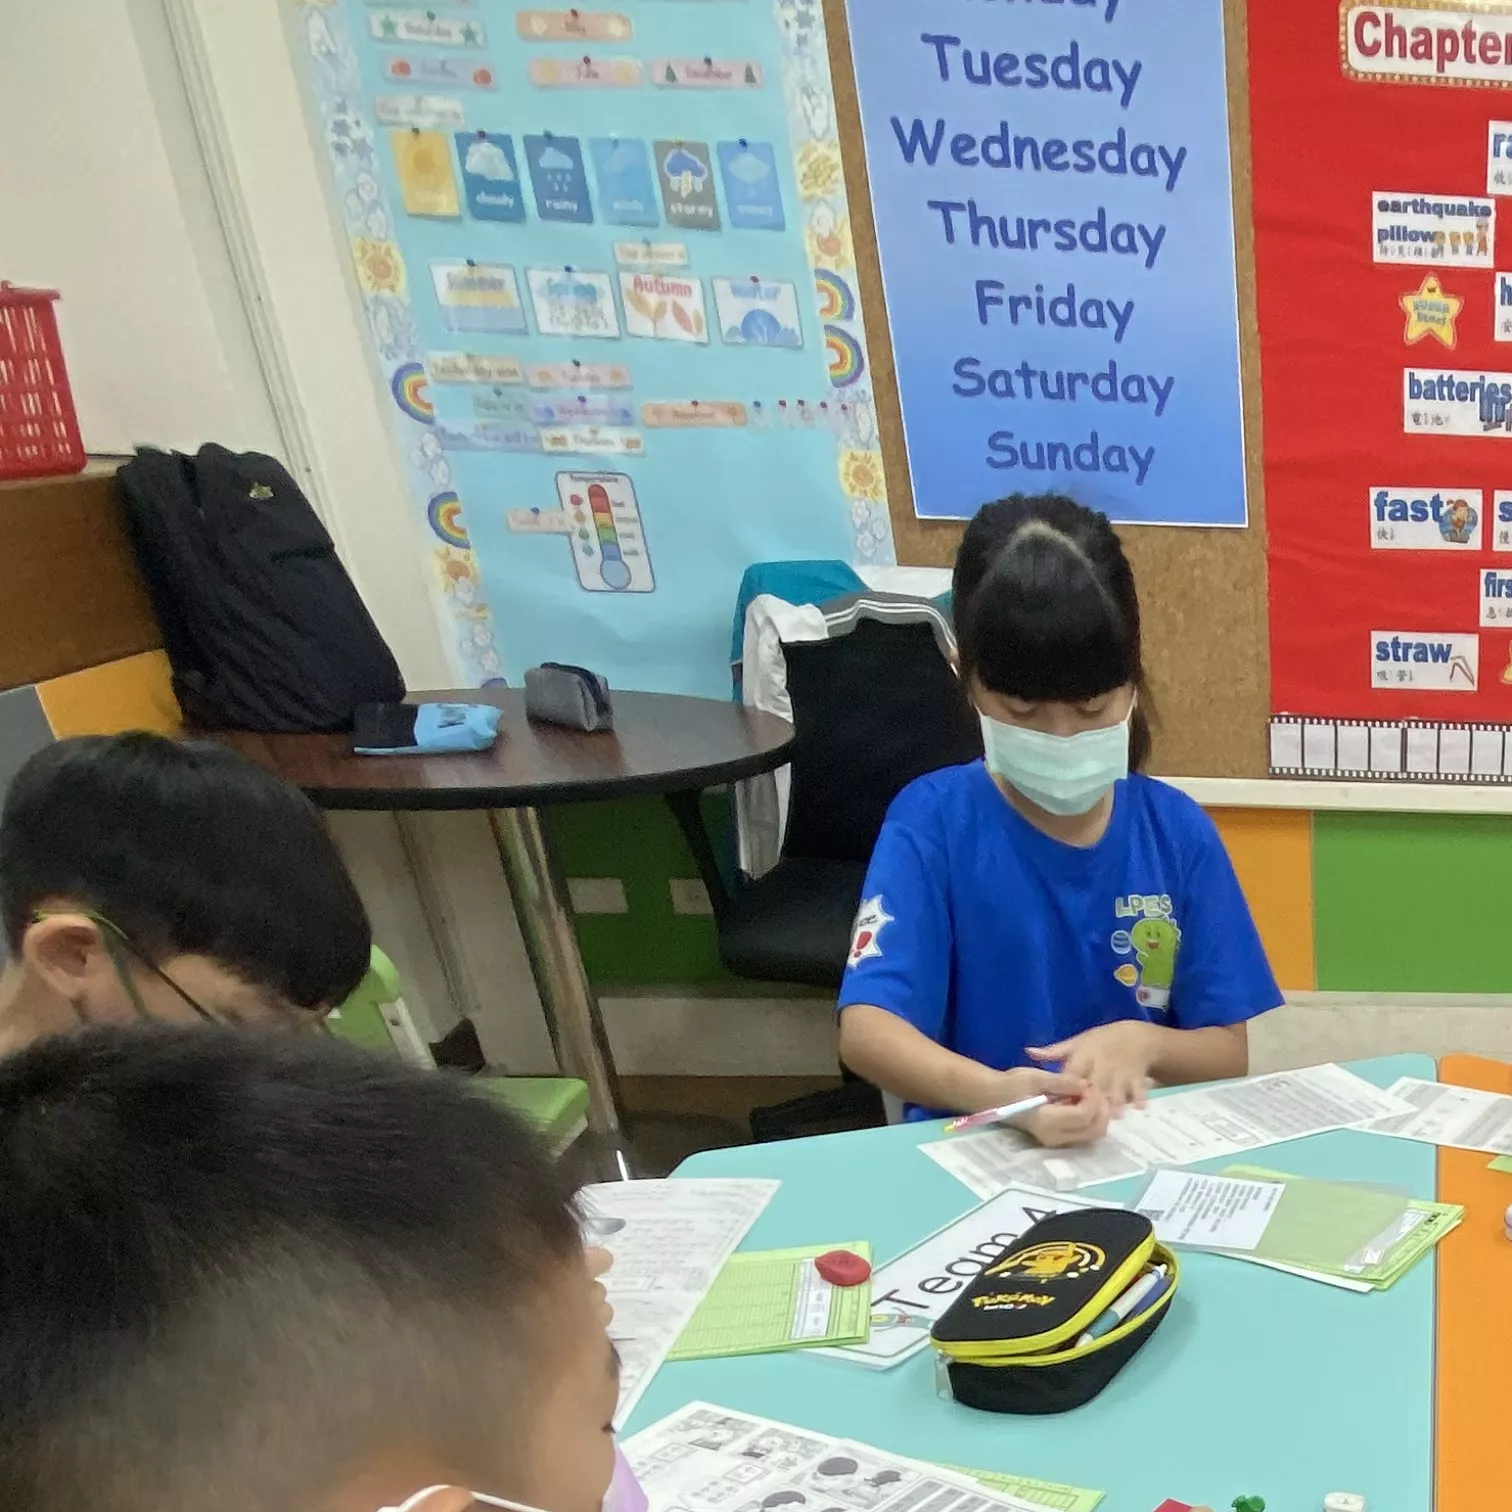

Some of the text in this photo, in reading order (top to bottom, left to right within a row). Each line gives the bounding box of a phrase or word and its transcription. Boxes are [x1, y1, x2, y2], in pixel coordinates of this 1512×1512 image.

[920, 33, 1143, 108] Tuesday
[890, 115, 1188, 192] Wednesday
[1377, 198, 1493, 219] earthquake
[927, 197, 1167, 269] Thursday
[1377, 225, 1438, 244] pillow
[633, 275, 692, 297] Autumn
[974, 279, 1135, 343] Friday
[952, 356, 1175, 417] Saturday
[1408, 371, 1512, 403] batteries
[985, 430, 1156, 486] Sunday
[1374, 491, 1445, 523] fast
[1375, 636, 1453, 664] straw
[1115, 893, 1173, 918] LPES
[871, 1232, 1019, 1310] Team
